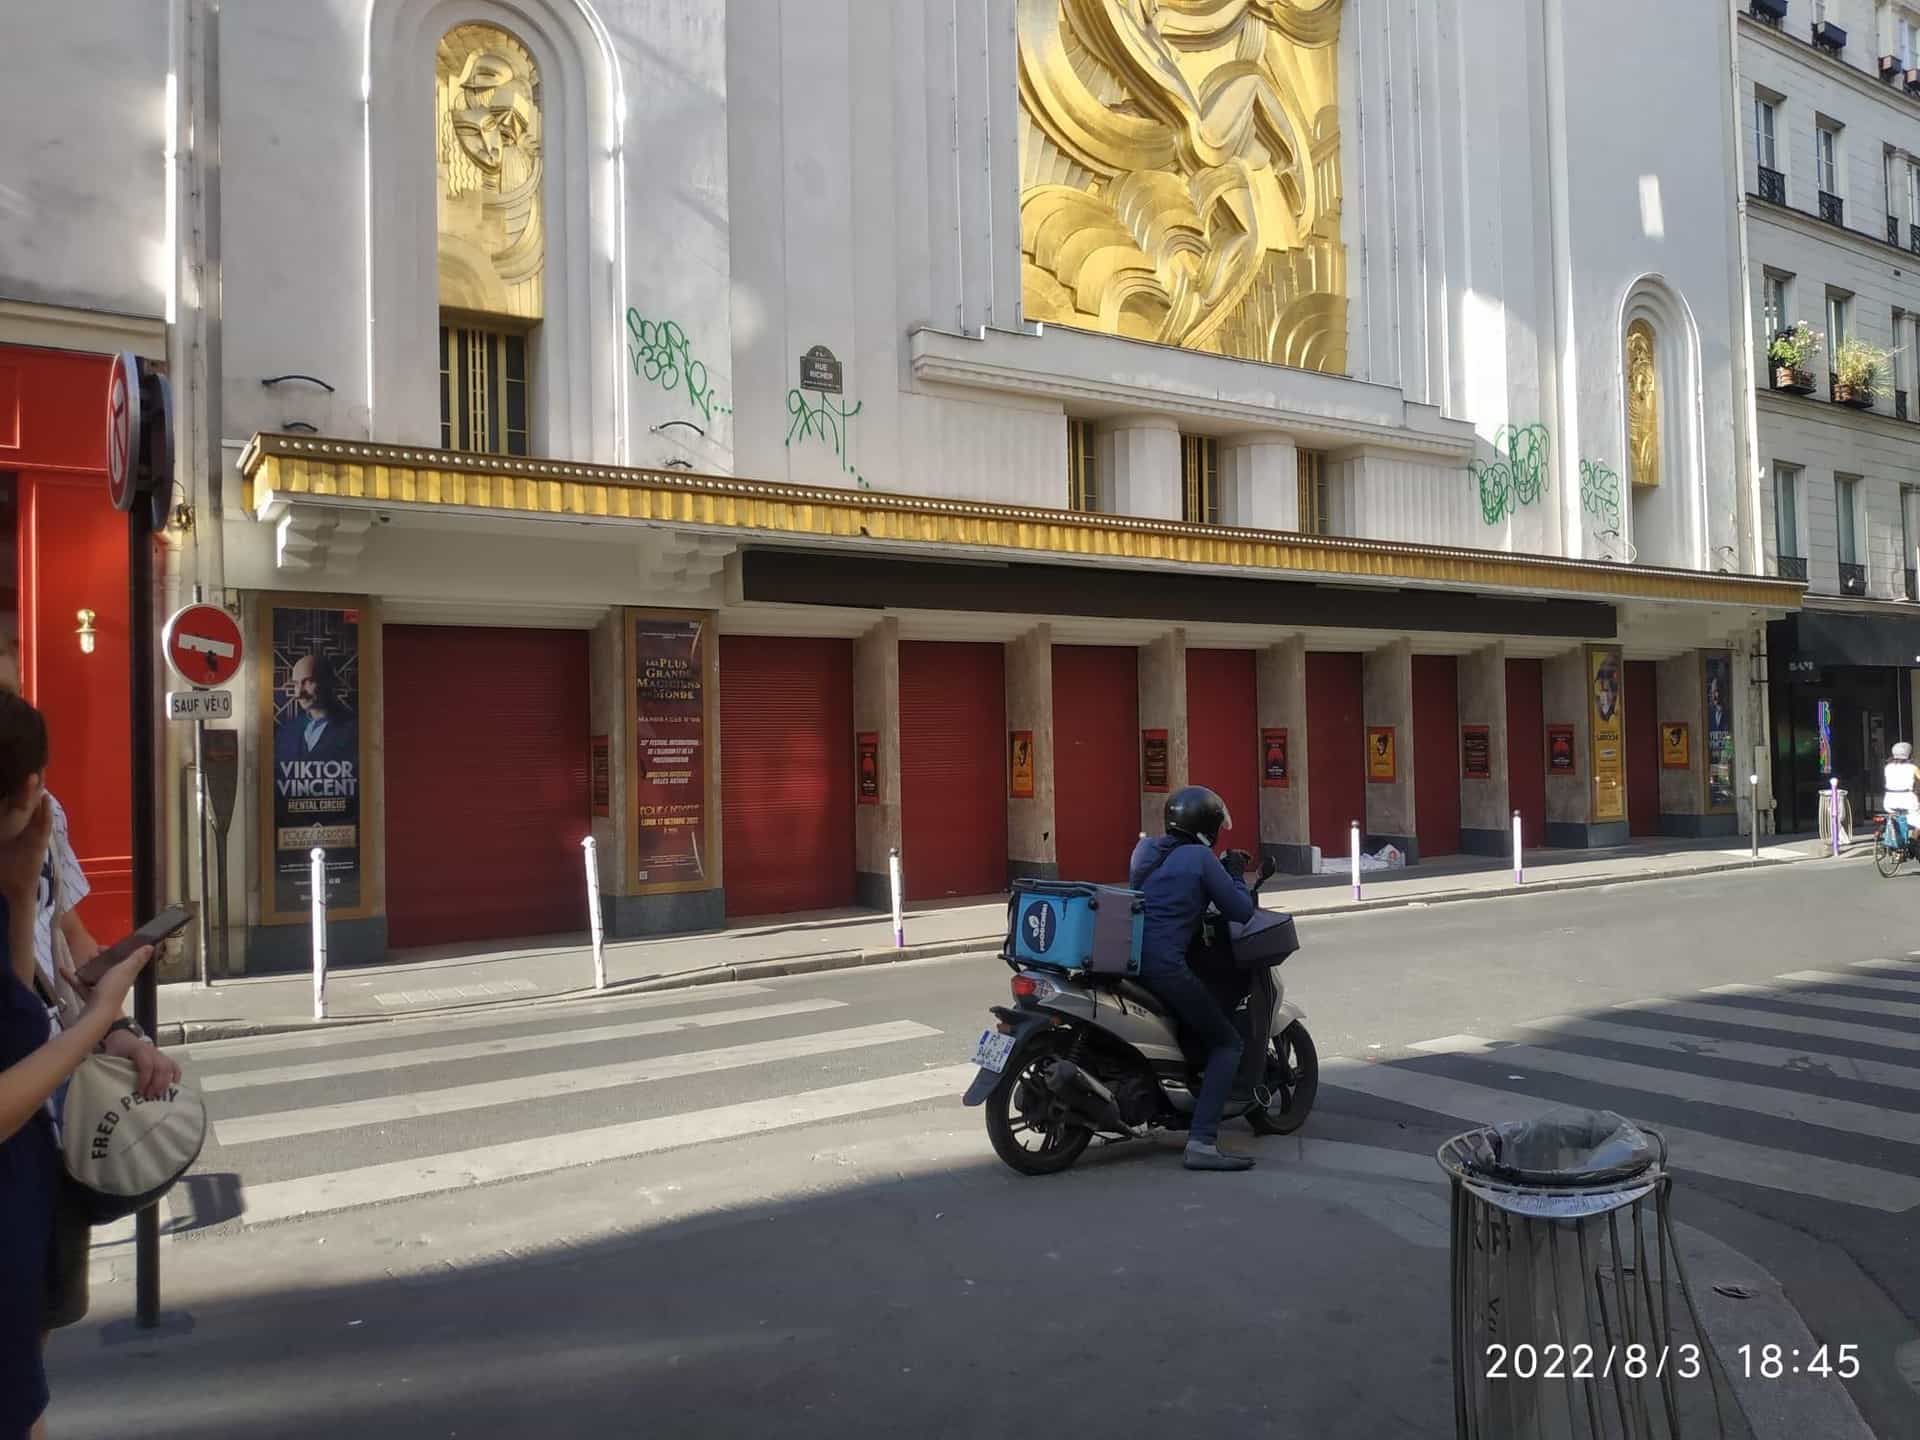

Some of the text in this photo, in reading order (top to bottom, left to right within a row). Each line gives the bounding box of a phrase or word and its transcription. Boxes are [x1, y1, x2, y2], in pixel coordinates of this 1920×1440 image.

[660, 658, 688, 669] PLUS
[174, 698, 199, 713] SAUF
[280, 760, 354, 779] VIKTOR
[276, 778, 357, 797] VINCENT
[91, 1087, 179, 1160] FRED PEY
